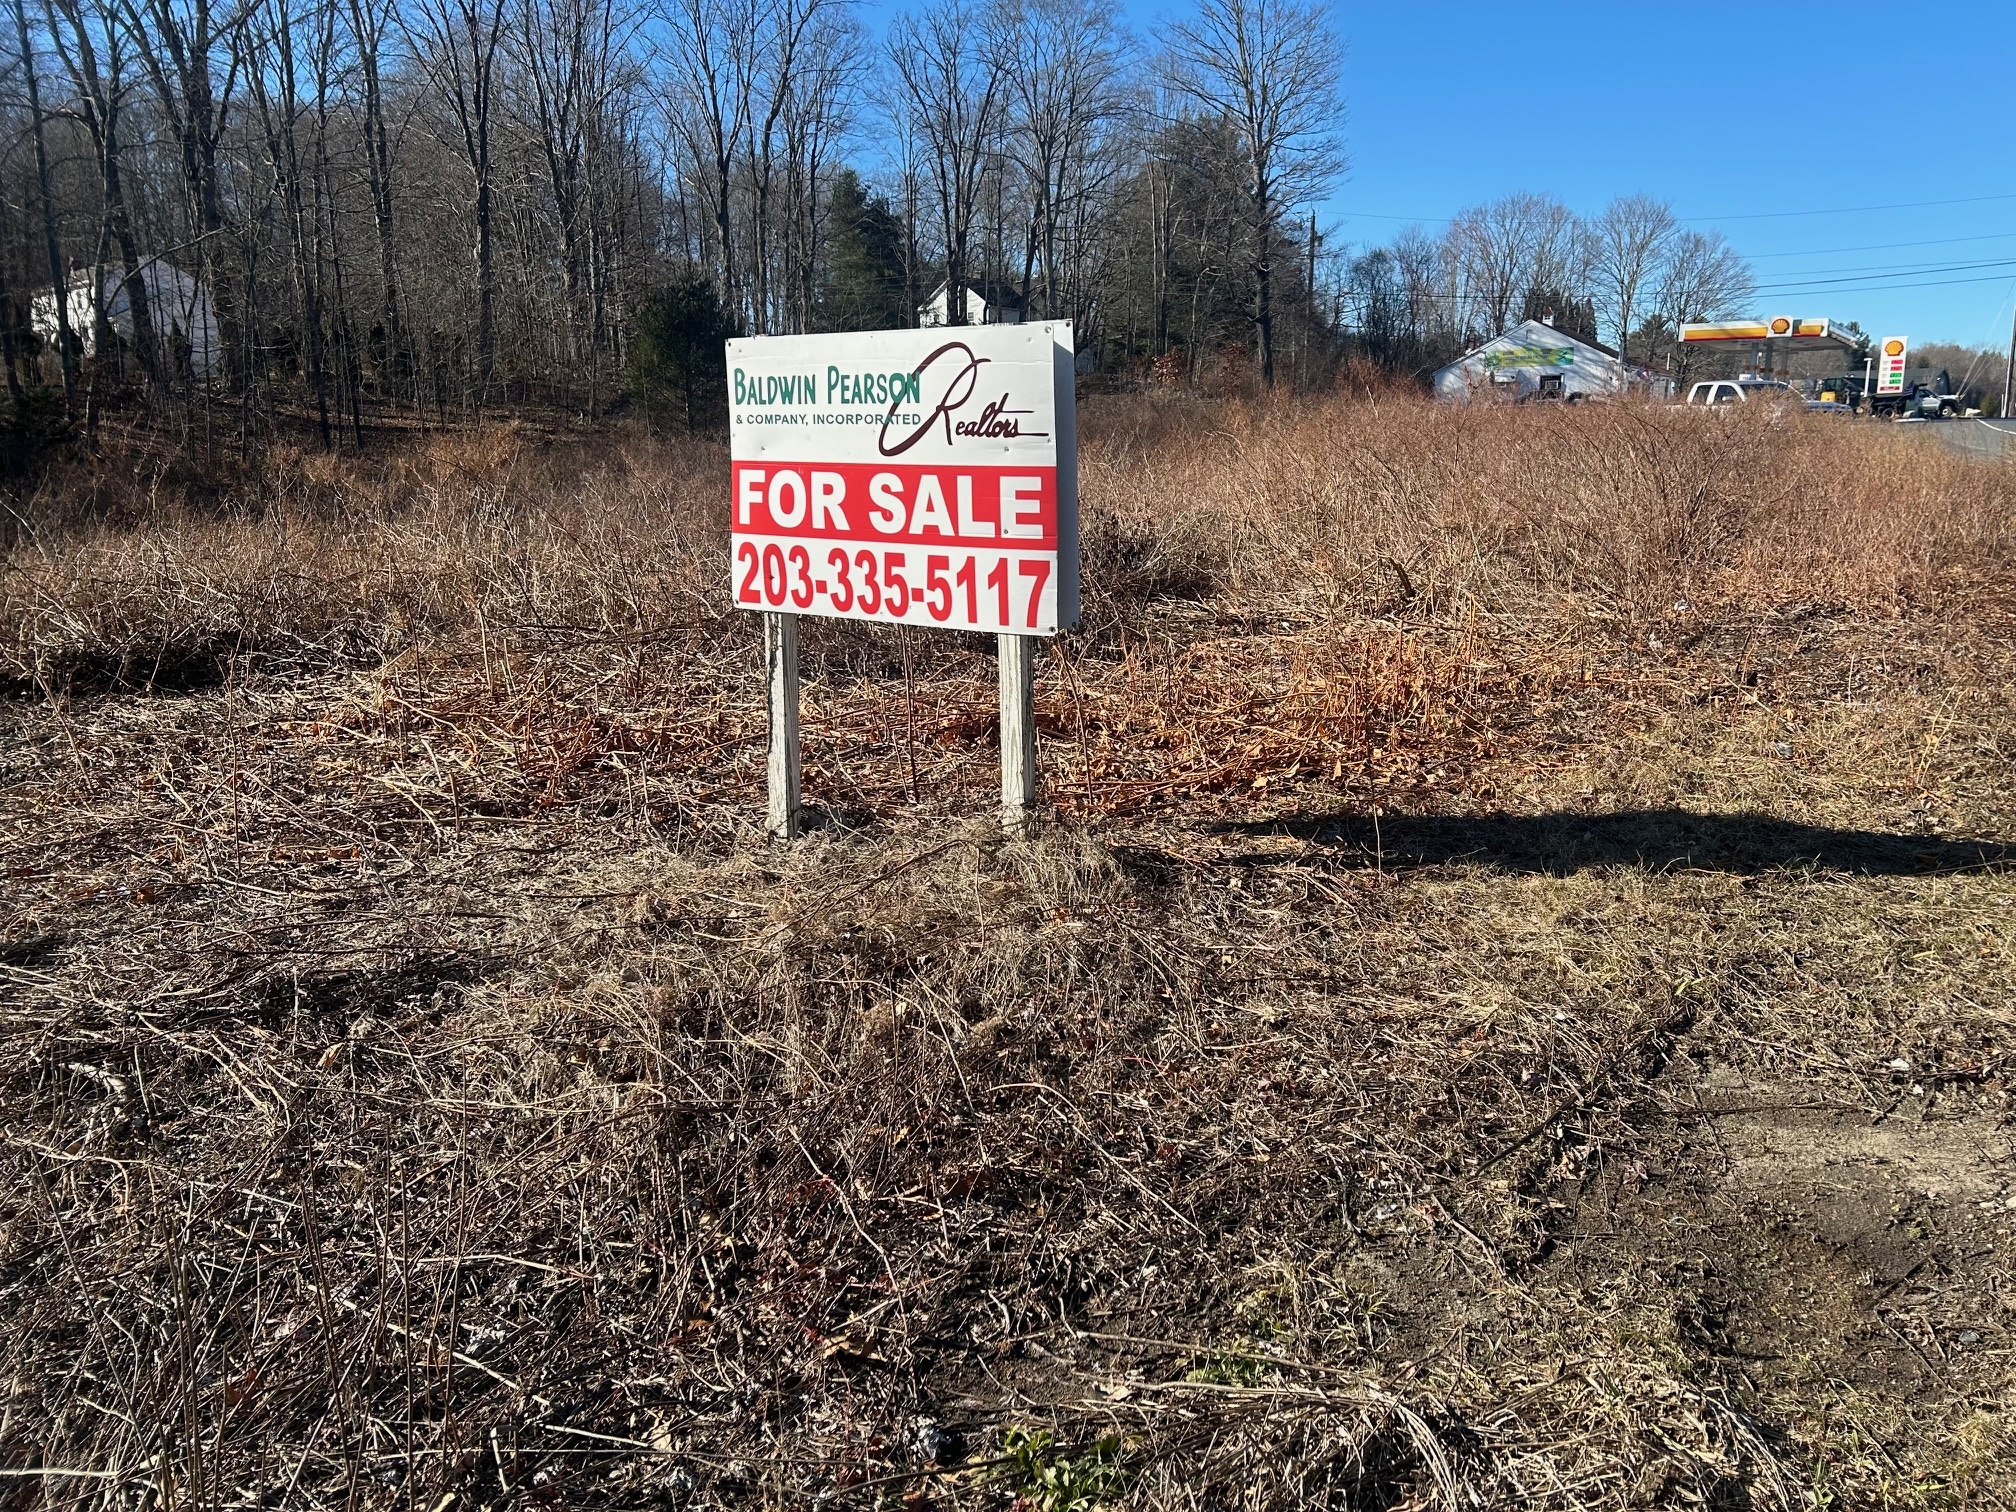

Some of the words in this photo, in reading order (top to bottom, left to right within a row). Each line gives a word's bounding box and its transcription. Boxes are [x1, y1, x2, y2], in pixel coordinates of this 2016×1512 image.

[734, 368, 816, 405] BALDWIN
[827, 365, 920, 404] PEARSON
[736, 415, 743, 424] &
[747, 414, 809, 426] COMPANY,
[812, 414, 921, 425] INCORPORATED
[879, 342, 1048, 456] Realtors
[738, 469, 850, 531] FOR
[868, 473, 1043, 540] SALE
[738, 542, 1050, 628] 203-335-5117
